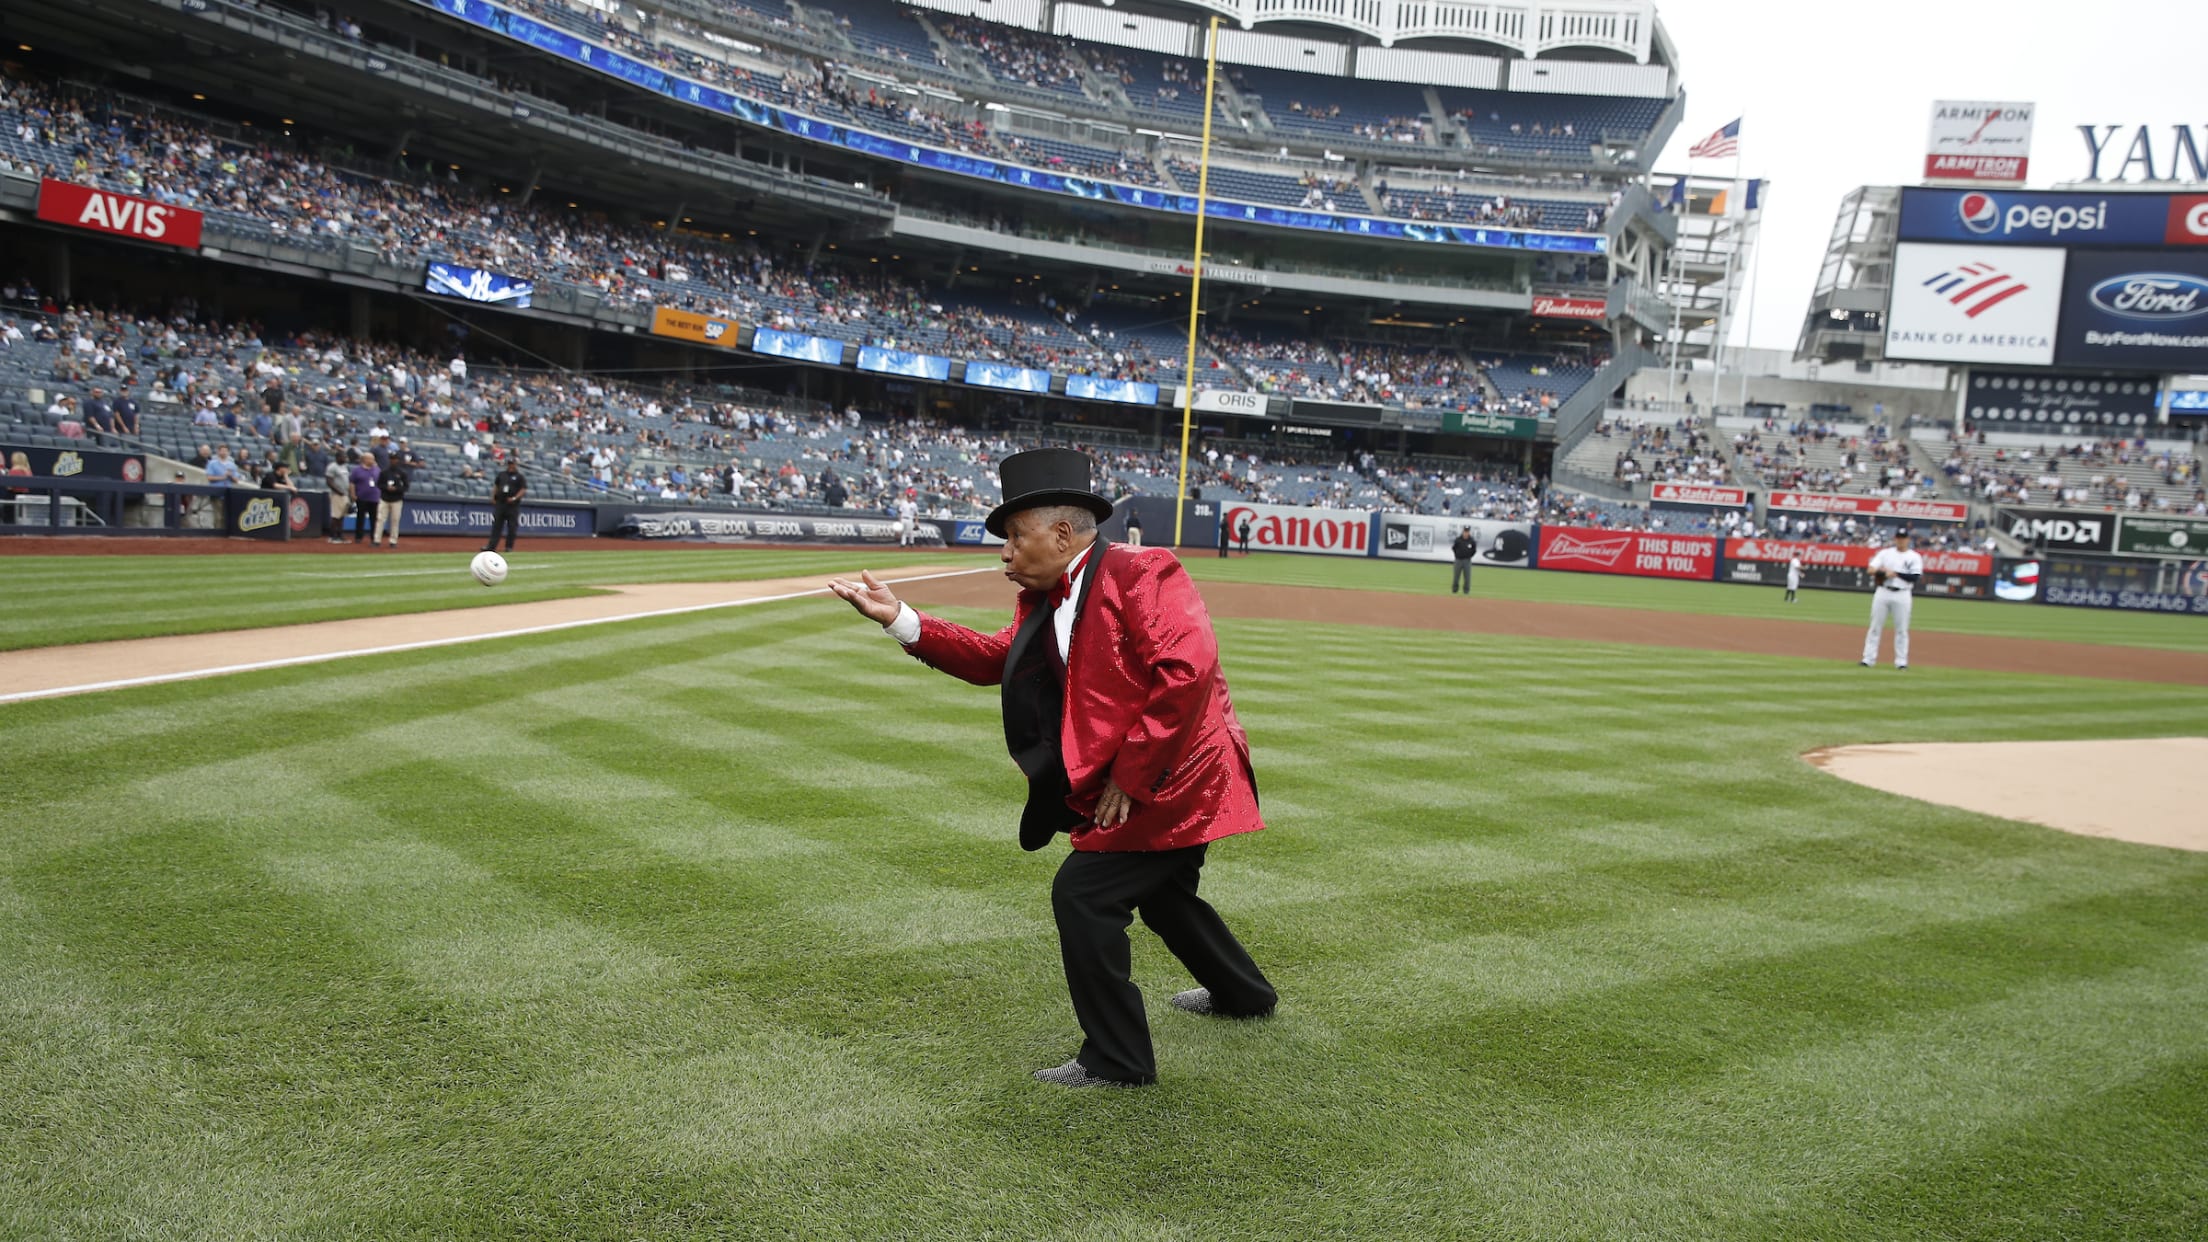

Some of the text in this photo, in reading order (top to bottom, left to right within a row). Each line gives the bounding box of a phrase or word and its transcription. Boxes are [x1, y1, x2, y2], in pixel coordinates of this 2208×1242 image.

[1934, 156, 2021, 171] ARMITRON
[79, 192, 167, 238] AVIS
[2003, 200, 2108, 236] pepsi
[2185, 202, 2208, 236] G
[1175, 264, 1204, 277] Aui
[2114, 280, 2200, 312] Ford
[1534, 300, 1604, 317] Budweiser
[705, 322, 724, 339] SAP
[1890, 330, 2049, 348] BANK OF AMERICA
[1218, 393, 1257, 408] ORIS
[411, 508, 460, 526] YANKEES
[469, 510, 496, 527] STEIN
[518, 513, 576, 529] OLLECTIBLES
[722, 519, 752, 536] COOL
[777, 520, 804, 536] COOL
[830, 522, 858, 537] COOL
[877, 524, 896, 537] COO
[1227, 506, 1368, 551] Canon
[2010, 518, 2076, 542] AMD
[1552, 540, 1622, 556] Budweiser
[1637, 537, 1713, 558] THIS BUD'S
[1636, 554, 1662, 571] FOR
[2045, 587, 2113, 607] StubHub
[2116, 590, 2188, 612] StubHub
[2191, 596, 2208, 612] S
